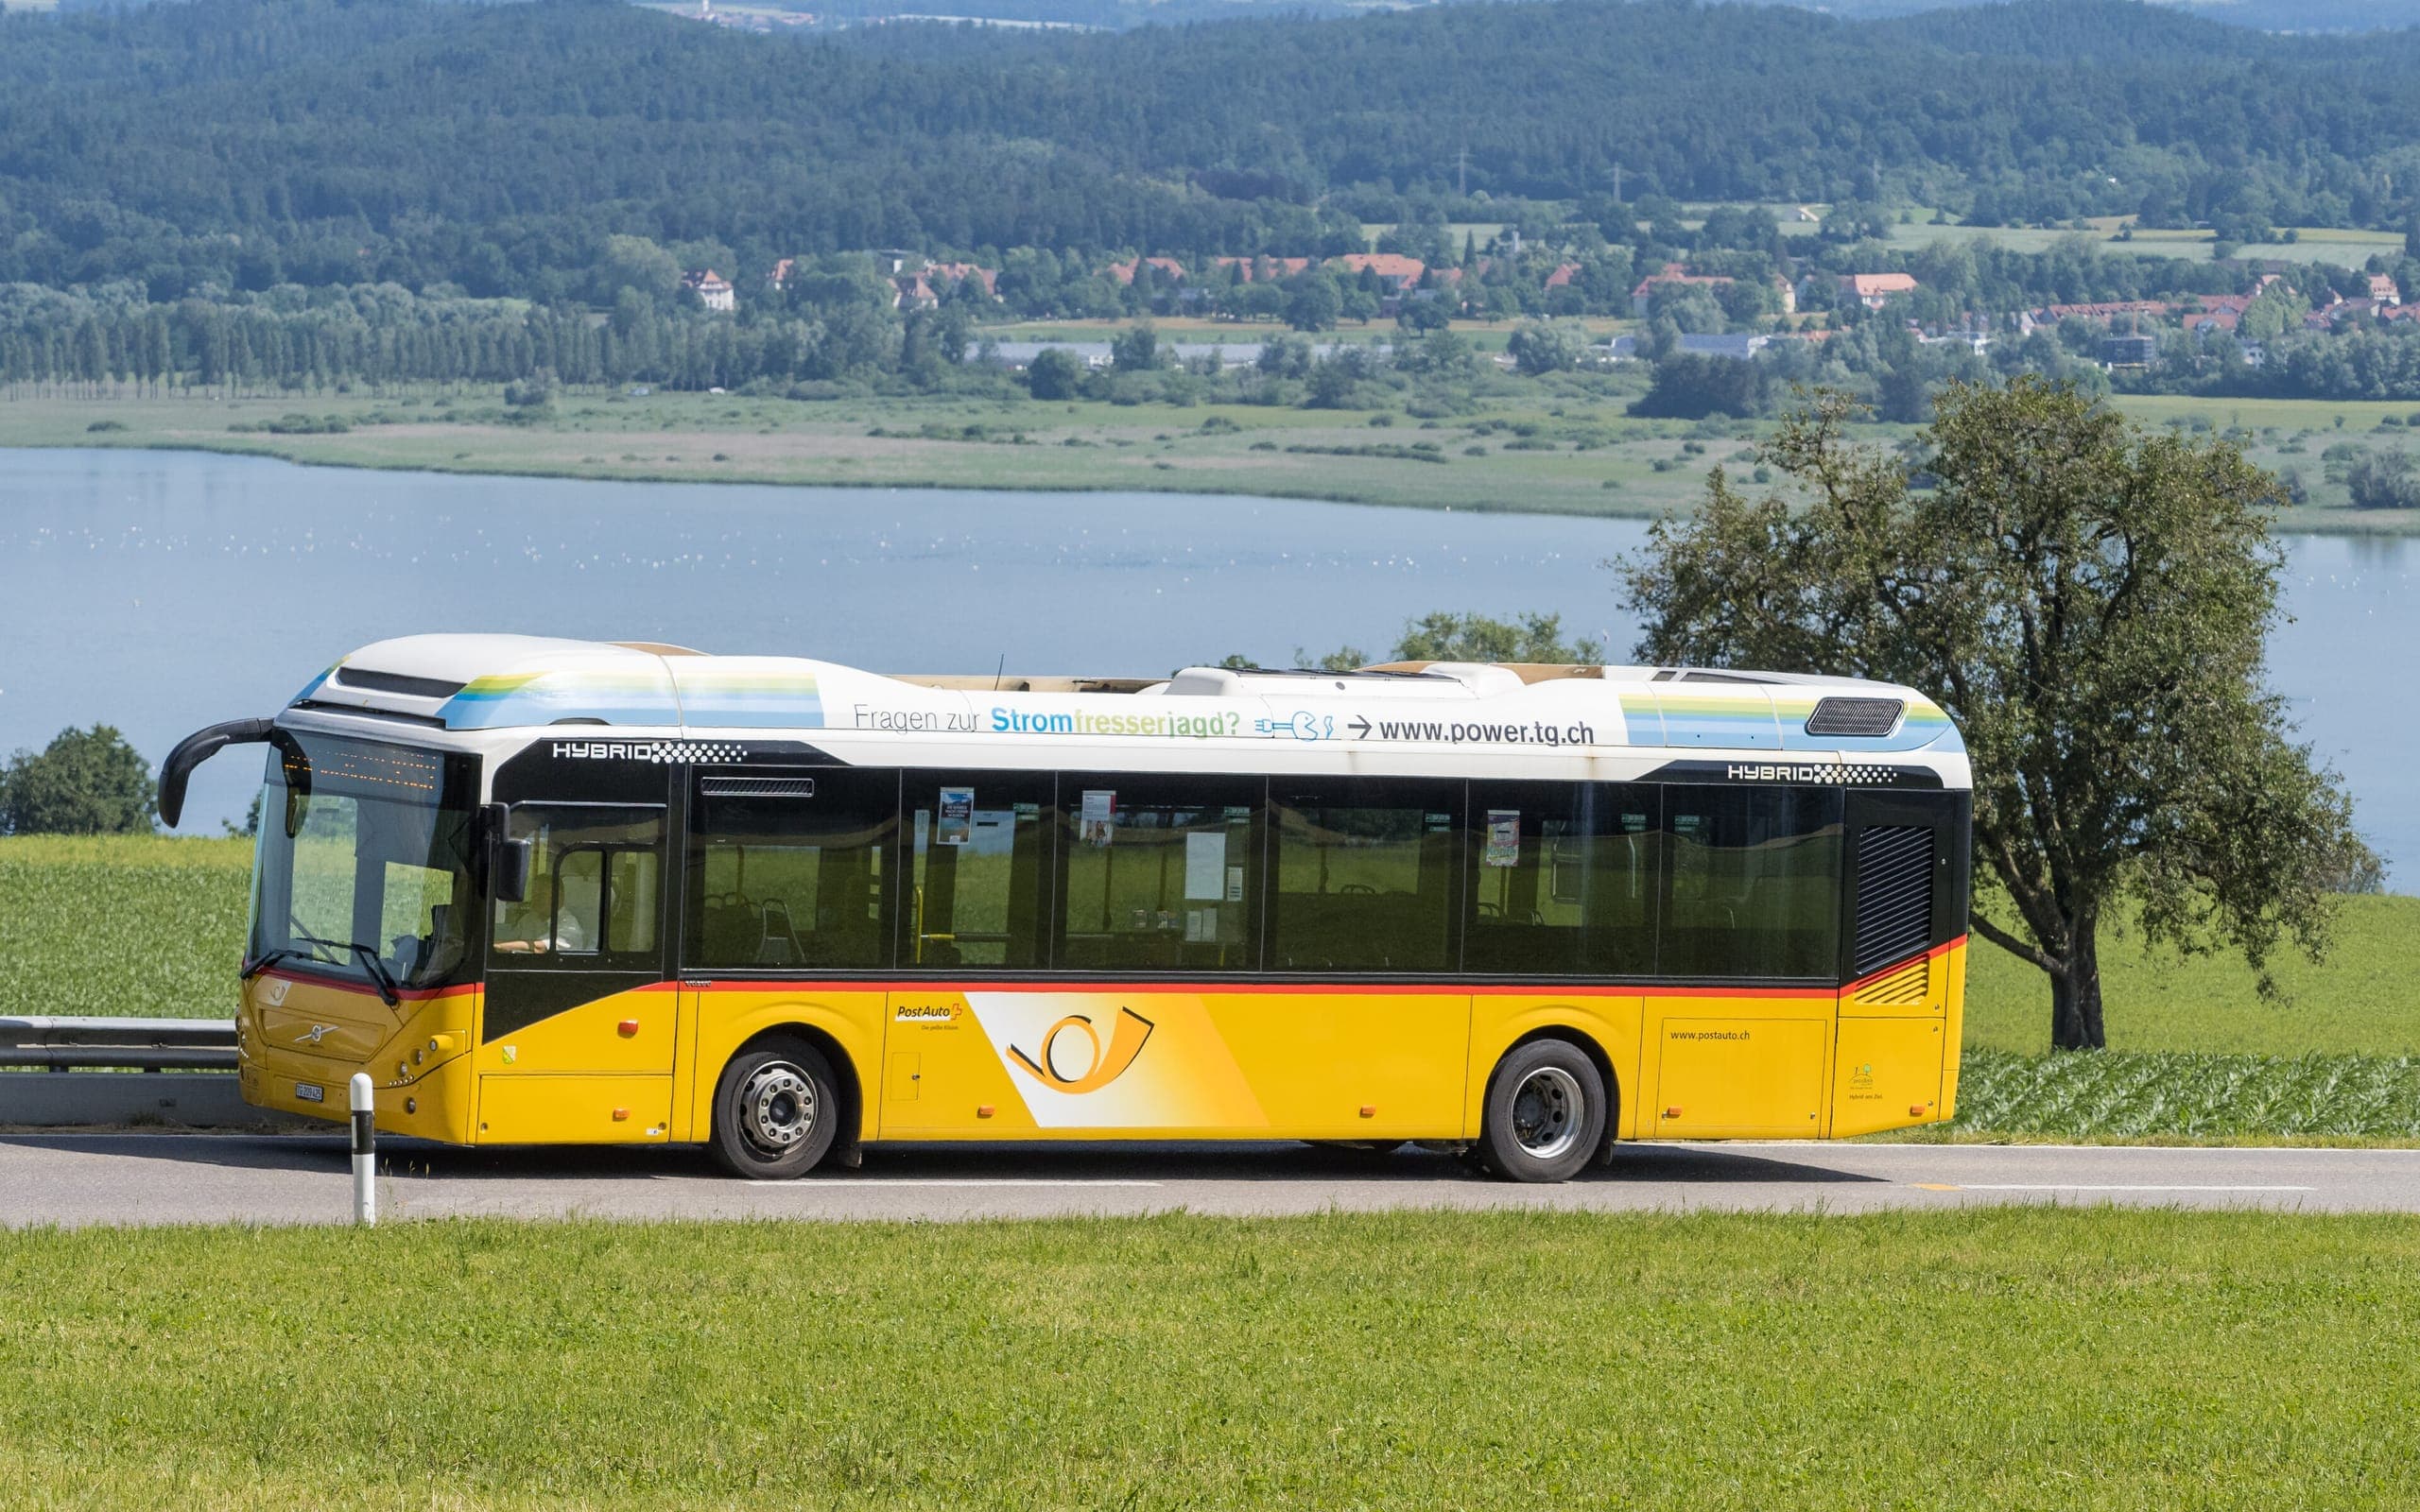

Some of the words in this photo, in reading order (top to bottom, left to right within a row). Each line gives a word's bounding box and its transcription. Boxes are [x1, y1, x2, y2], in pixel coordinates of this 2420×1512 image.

[854, 703, 938, 735] Fragen
[946, 712, 980, 731] zur
[991, 707, 1240, 740] Stromfresserjagd?
[1379, 720, 1595, 747] www.power.tg.ch
[552, 743, 652, 761] HYBRID
[1728, 764, 1814, 782] HYBRID
[1670, 1030, 1750, 1042] www.postauto.ch
